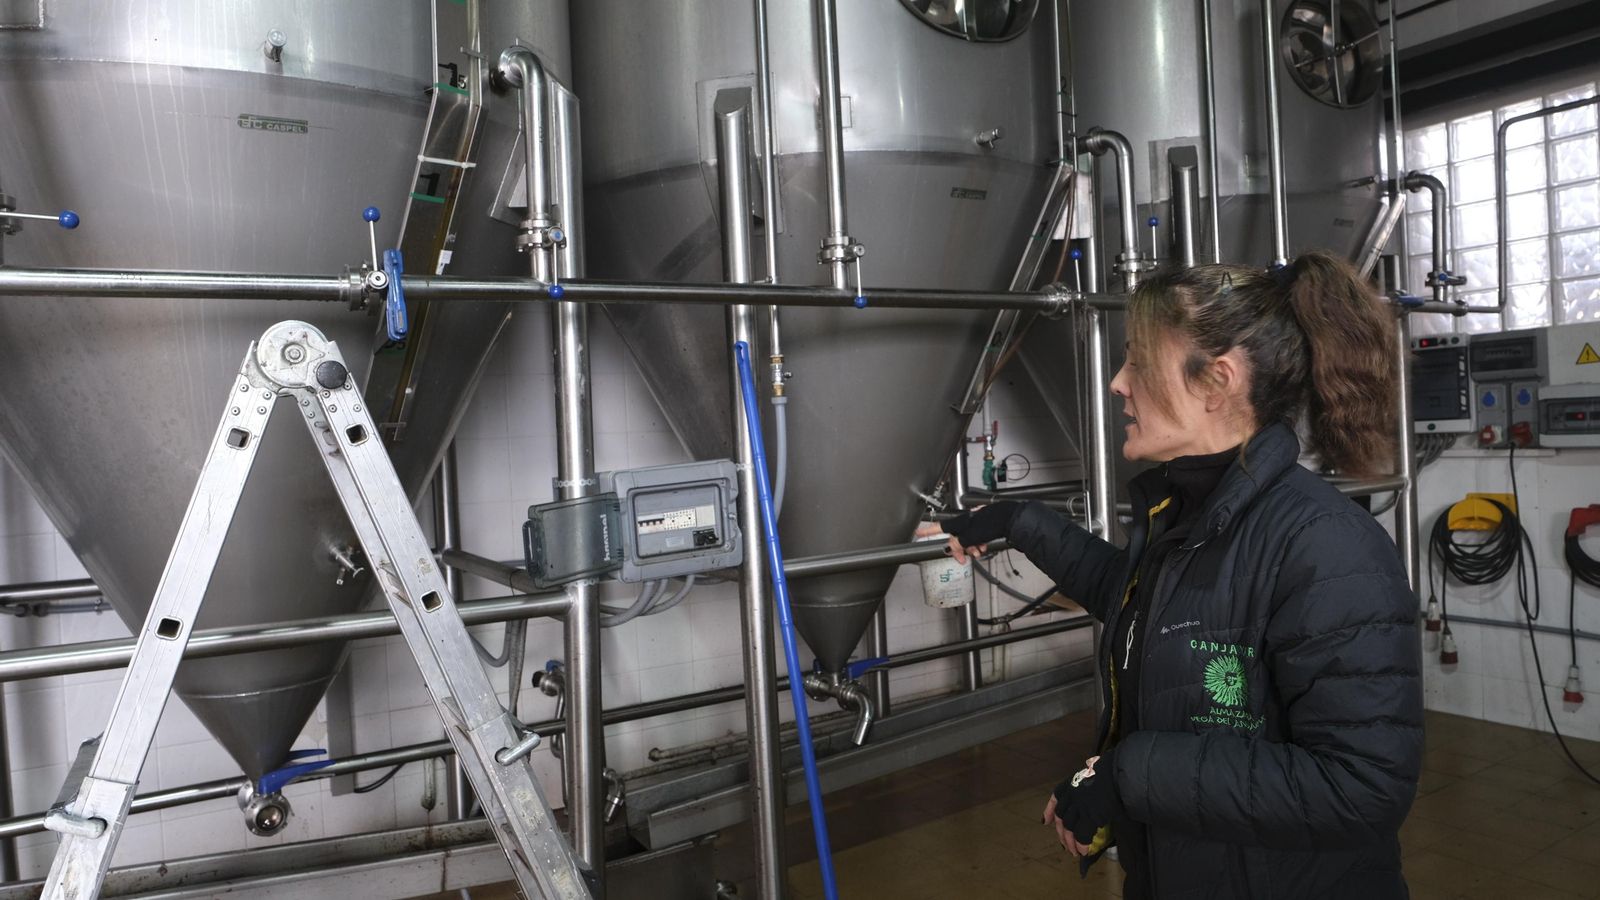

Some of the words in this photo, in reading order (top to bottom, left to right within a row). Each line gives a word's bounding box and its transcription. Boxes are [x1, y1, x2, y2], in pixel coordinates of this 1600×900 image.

[266, 123, 305, 134] CASPEL
[1170, 620, 1201, 631] Quechua
[1216, 716, 1232, 726] DEL
